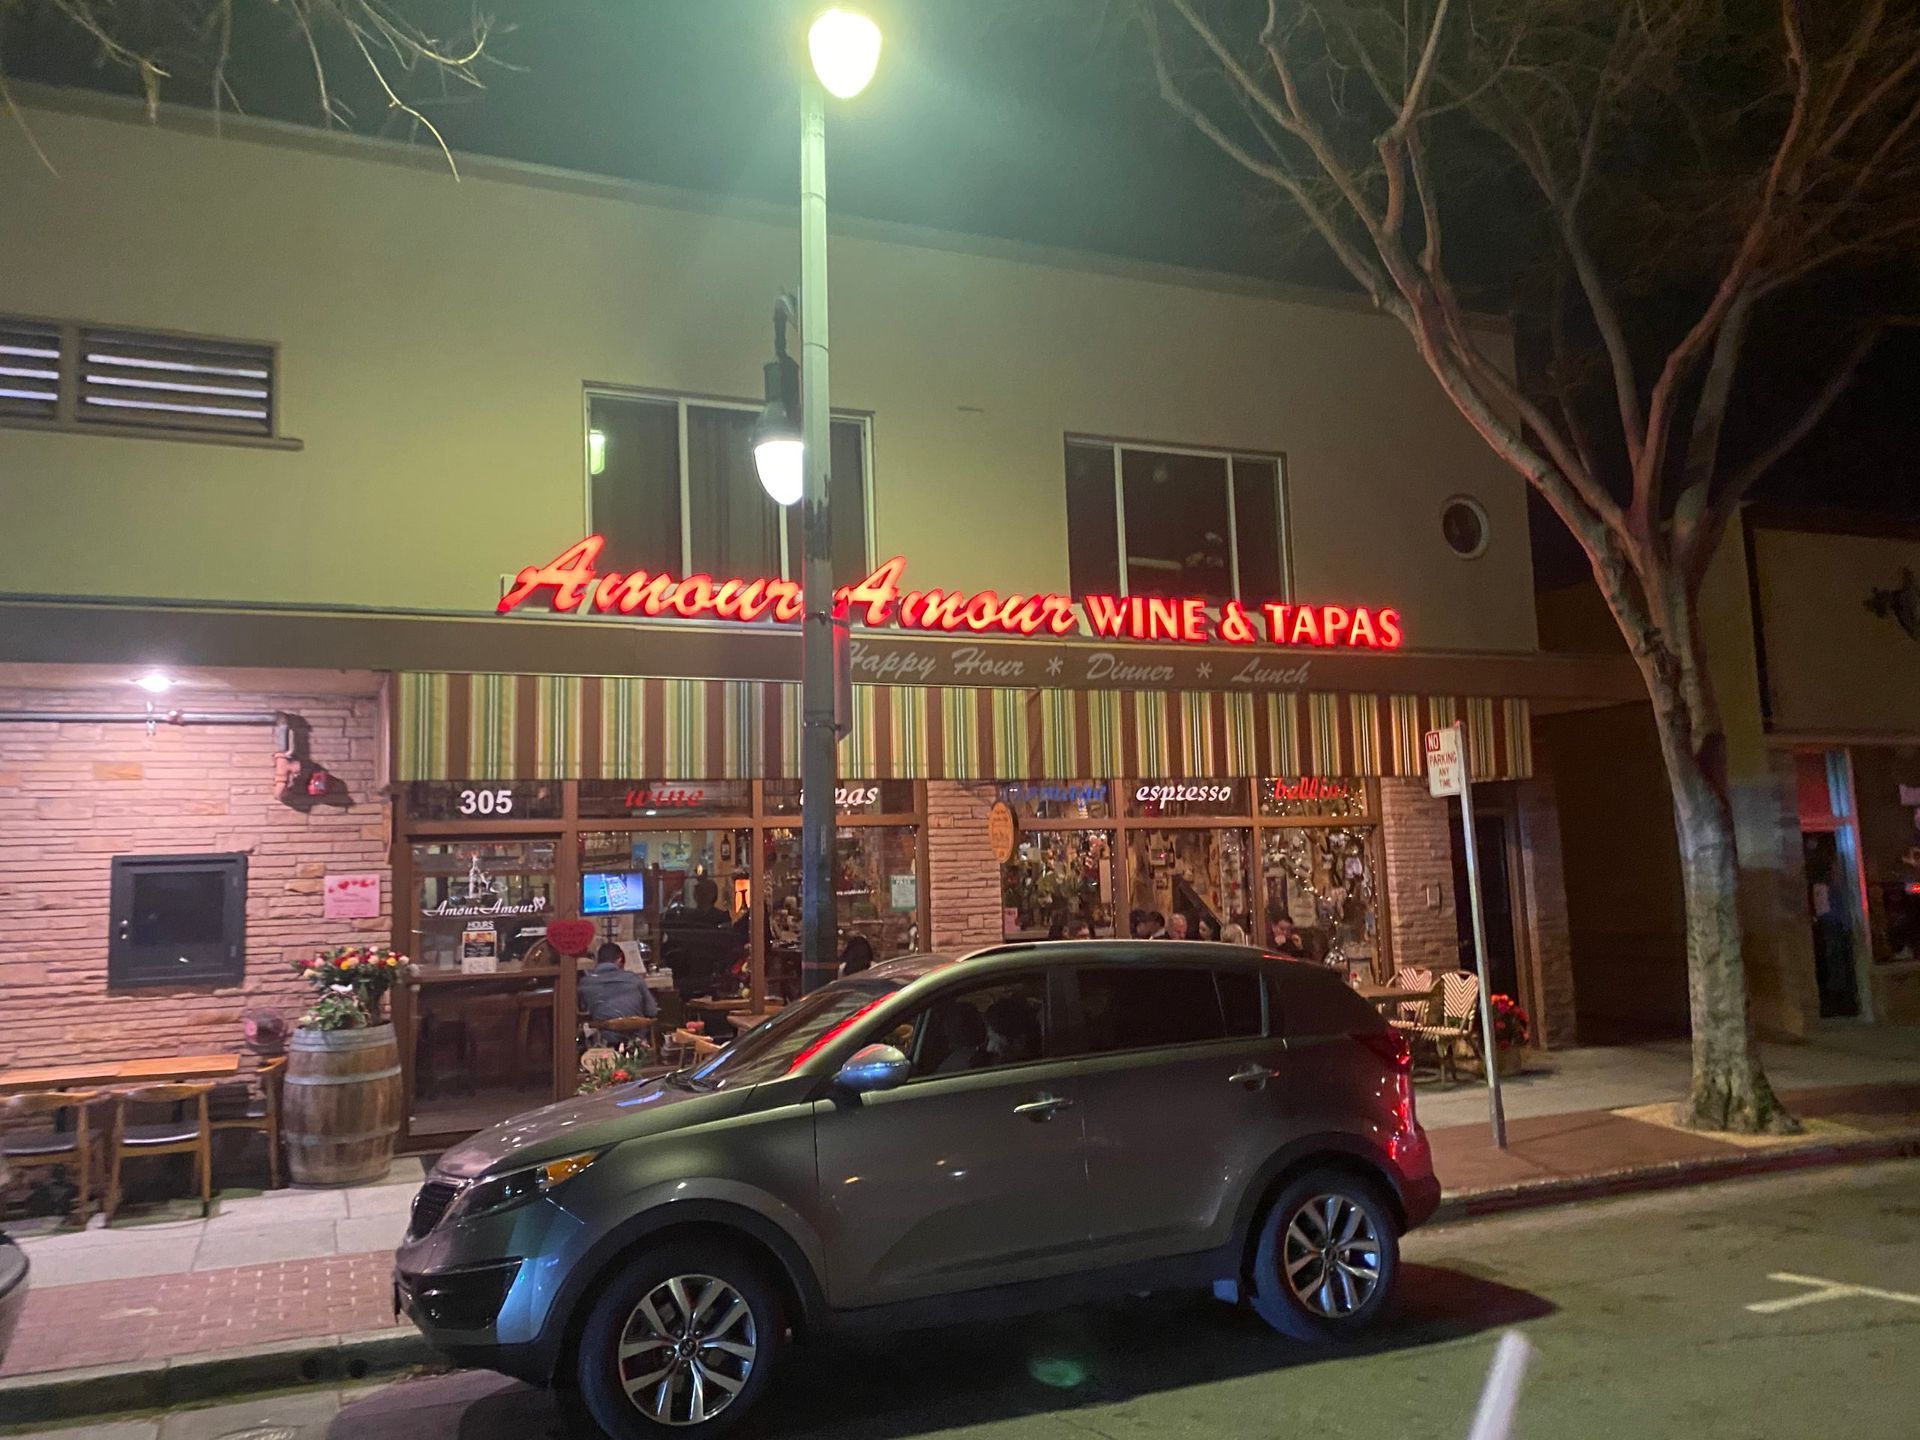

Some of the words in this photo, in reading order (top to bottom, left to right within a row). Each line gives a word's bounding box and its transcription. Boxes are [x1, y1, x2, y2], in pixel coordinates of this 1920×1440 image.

[497, 534, 804, 622] Amour
[833, 556, 1077, 636] Amour
[1084, 594, 1207, 641] WINE
[1220, 600, 1255, 643] &
[1263, 602, 1402, 648] TAPAS
[849, 641, 937, 681] Happy
[951, 646, 1025, 677] Hour
[1087, 653, 1175, 682] Dinner
[1232, 656, 1310, 686] Lunch
[1428, 734, 1440, 750] NO
[1429, 752, 1457, 767] PARKING
[1439, 768, 1449, 777] ANY
[1440, 779, 1451, 789] TIME
[460, 790, 512, 814] 305
[624, 780, 704, 808] wine
[1135, 785, 1231, 809] espresso
